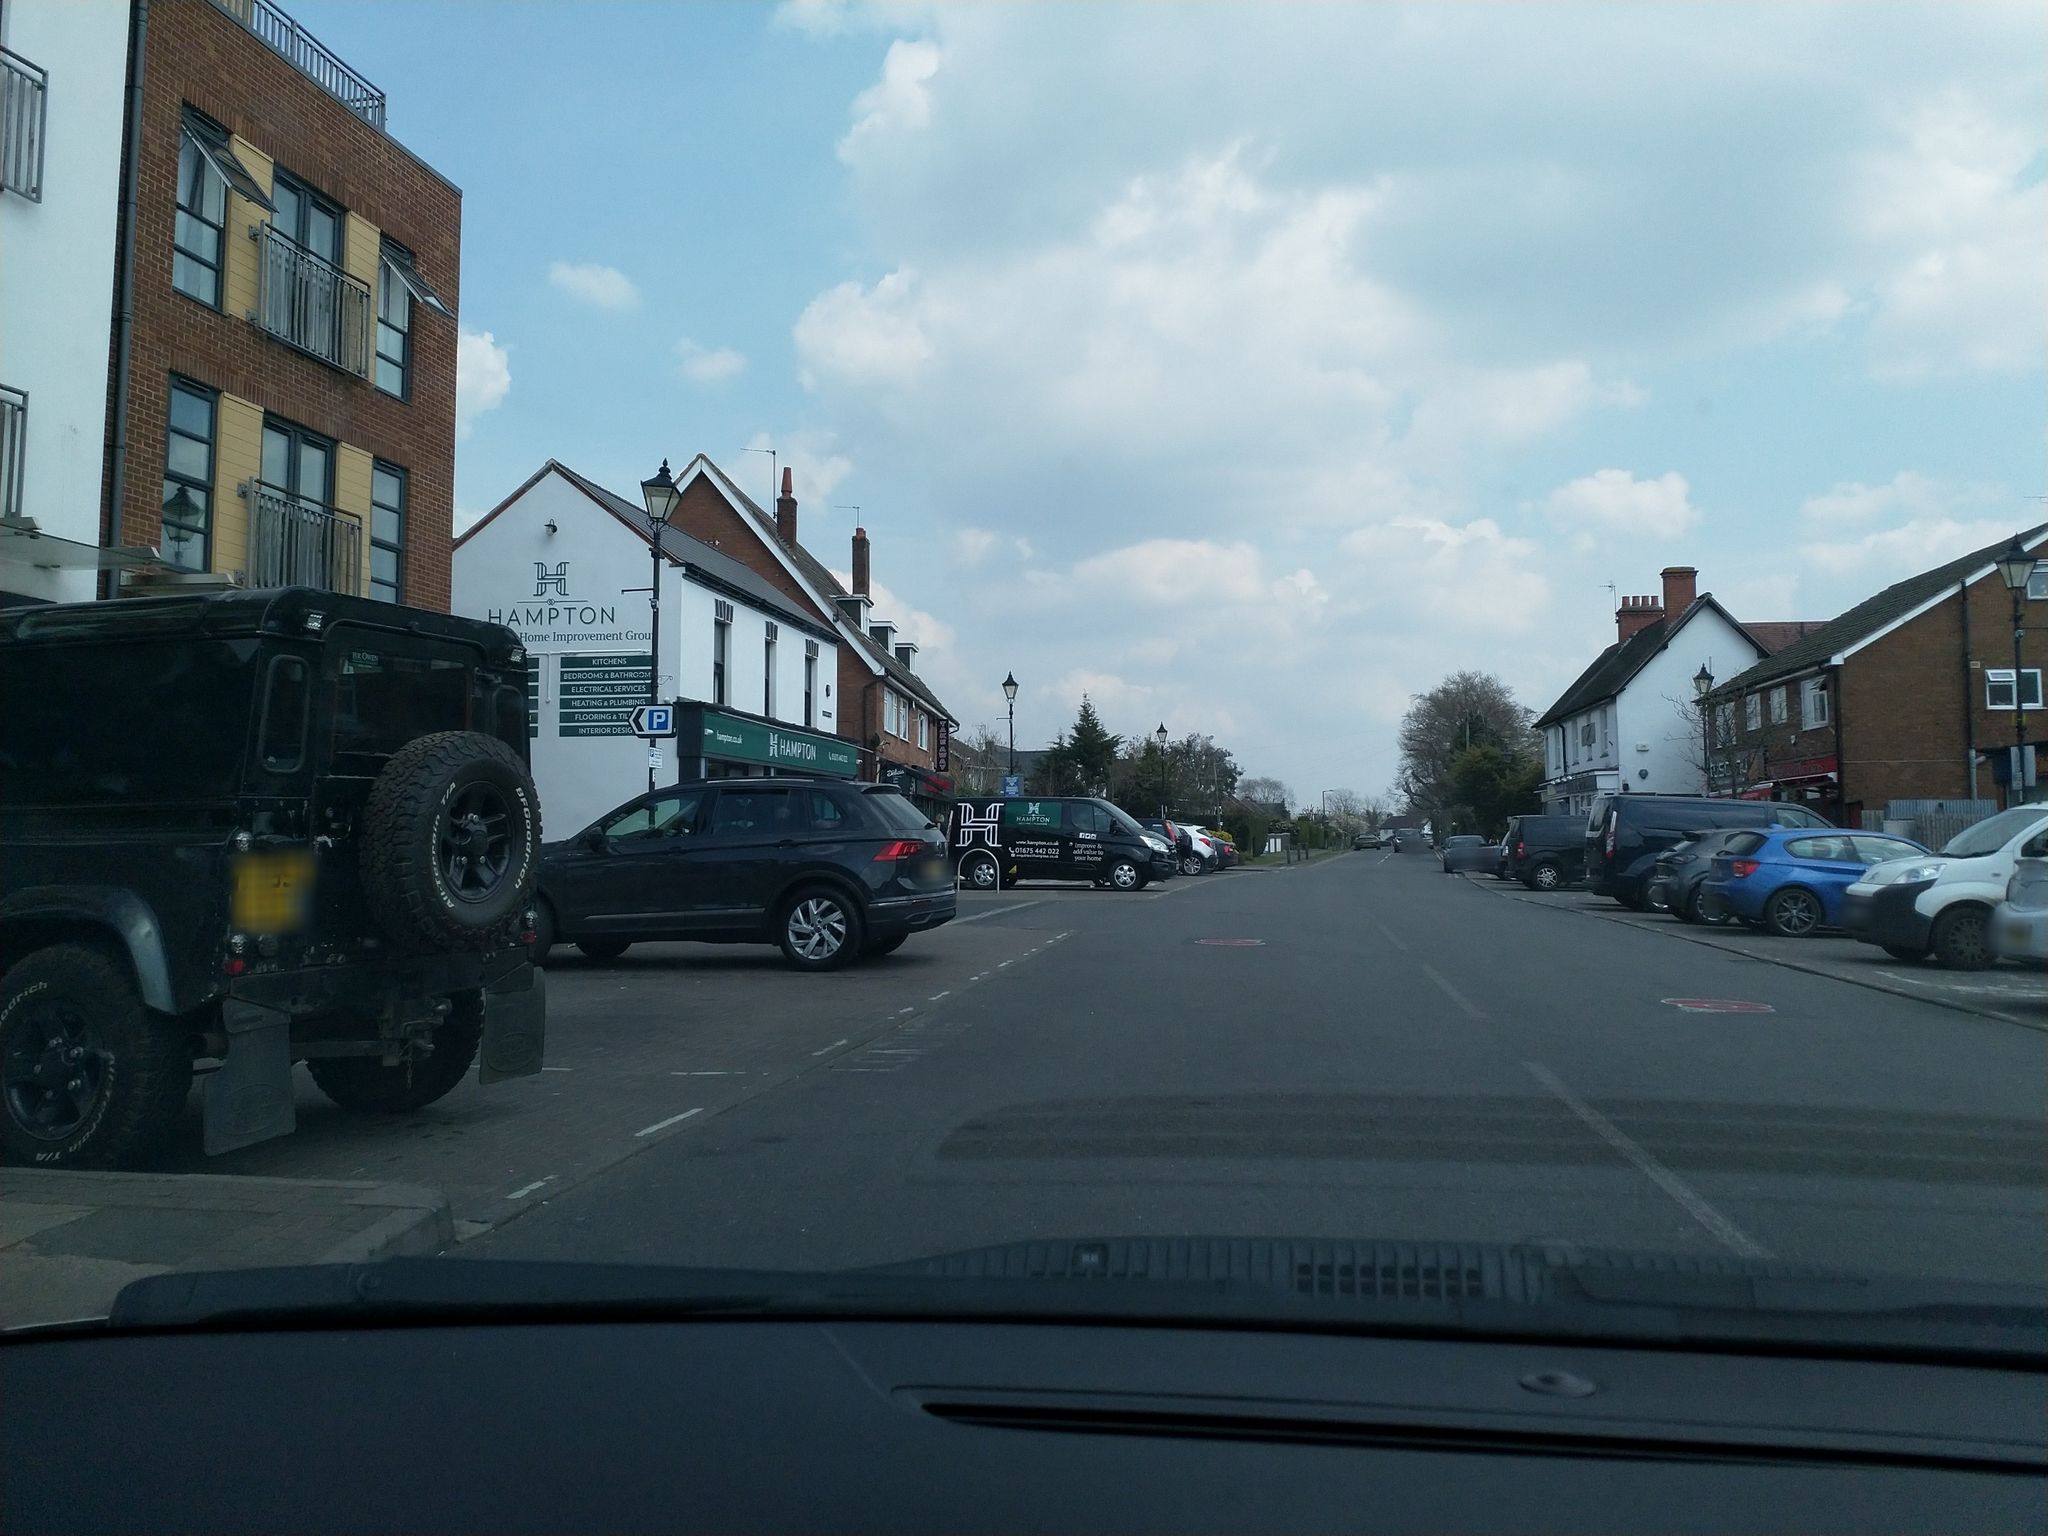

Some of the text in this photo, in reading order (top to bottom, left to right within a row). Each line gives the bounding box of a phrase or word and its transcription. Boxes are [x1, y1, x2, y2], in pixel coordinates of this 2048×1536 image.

[488, 606, 615, 626] HAMPTON
[520, 630, 653, 644] Home Improvement Grou
[592, 658, 627, 666] KITCHENS
[563, 672, 603, 680] BEDROOMS
[610, 671, 651, 679] BATHROOM
[609, 698, 646, 706] PLUMBING
[575, 713, 611, 721] FLOORING
[653, 711, 666, 729] P
[780, 738, 817, 761] HAMPTON
[0, 981, 48, 1022] odrich
